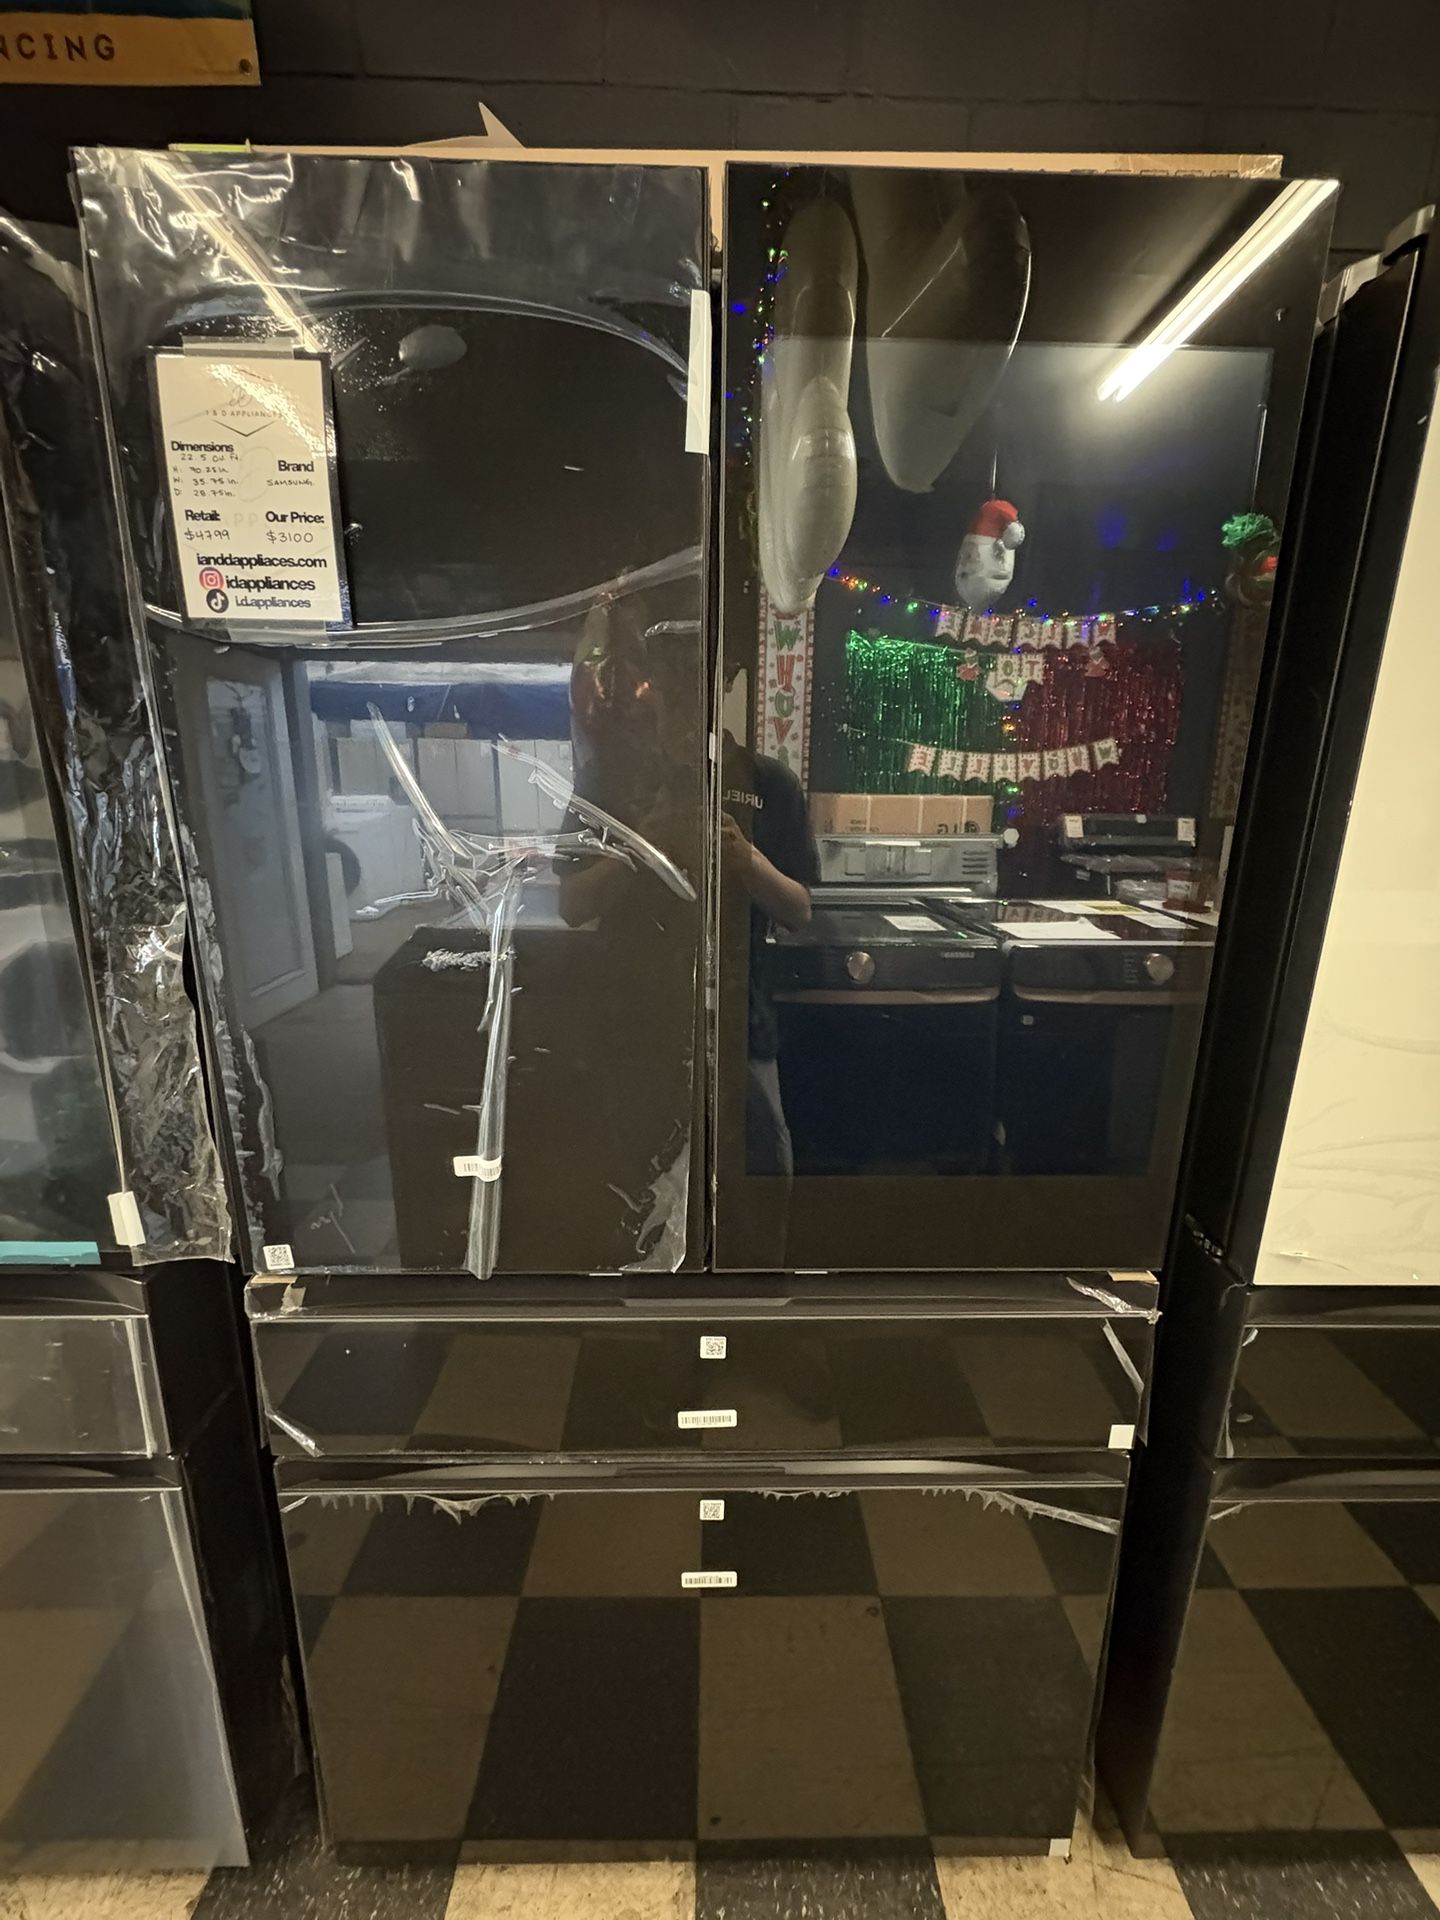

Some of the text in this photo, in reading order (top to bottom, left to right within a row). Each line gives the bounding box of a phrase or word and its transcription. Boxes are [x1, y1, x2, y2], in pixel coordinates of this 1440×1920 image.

[221, 410, 228, 418] D
[171, 441, 234, 452] Dimensions
[278, 460, 314, 472] Brand
[265, 511, 289, 523] Our
[290, 511, 325, 525] Price:
[184, 527, 230, 541] $4799
[266, 530, 313, 544] $3100
[196, 552, 328, 570] ianddappliaces.com
[225, 575, 316, 592] idappliances
